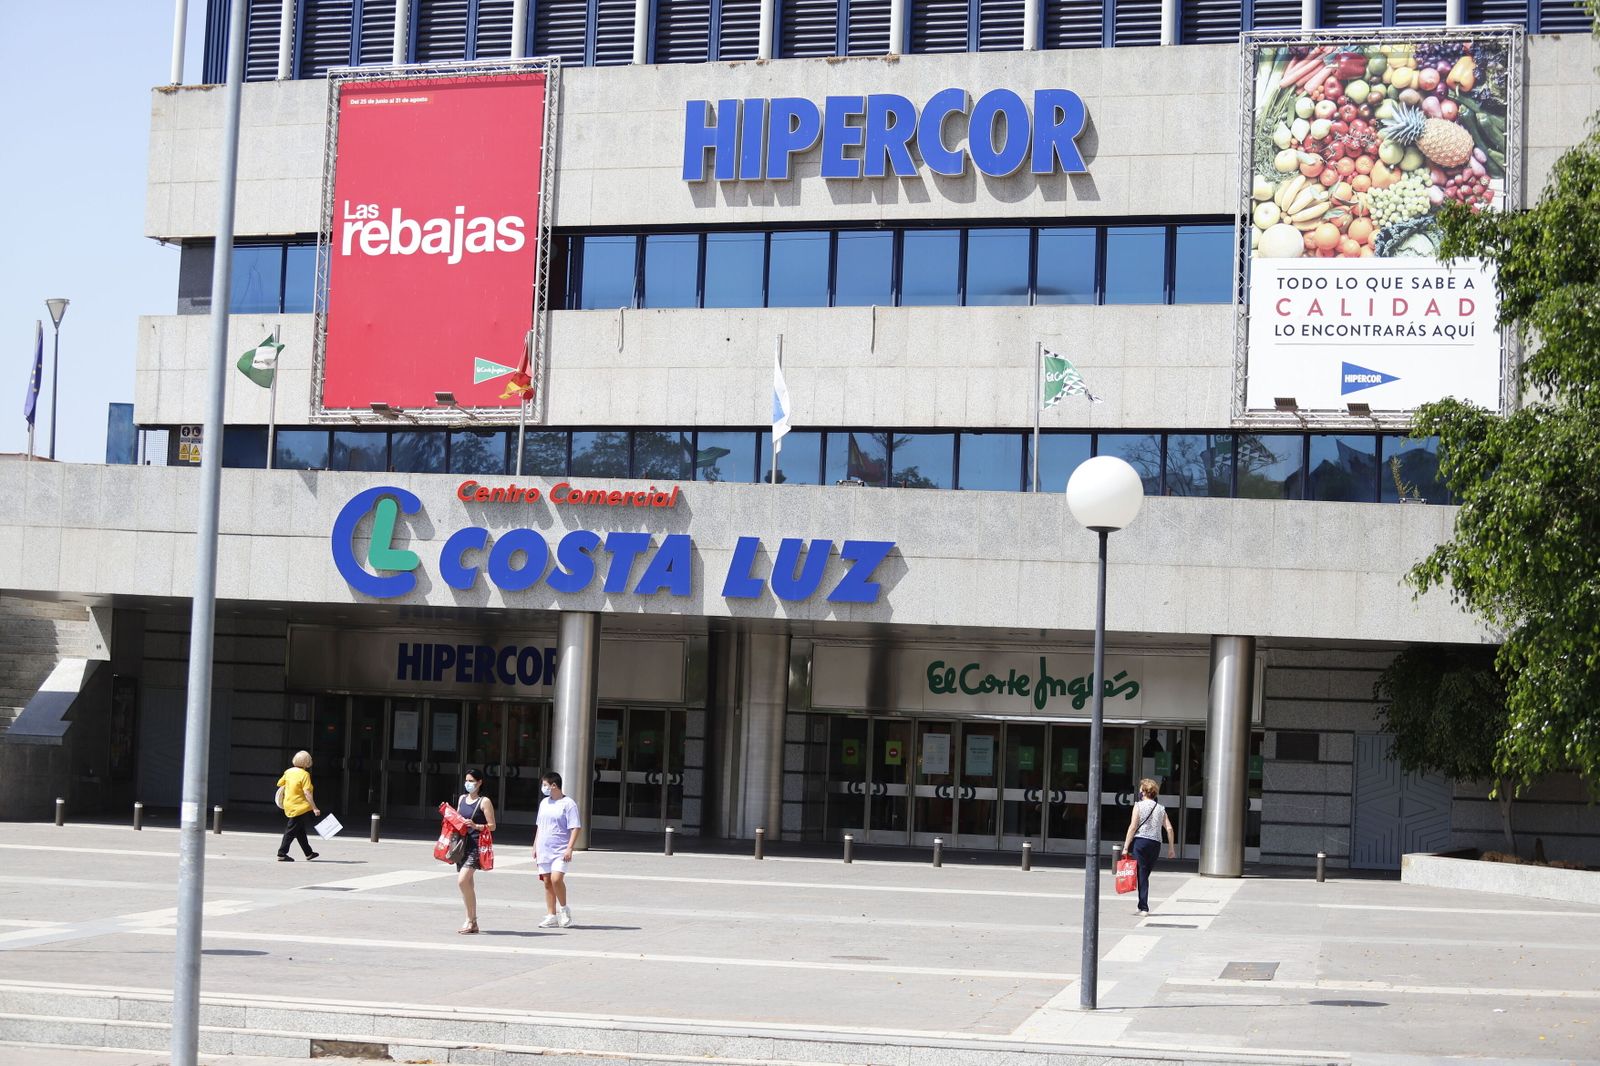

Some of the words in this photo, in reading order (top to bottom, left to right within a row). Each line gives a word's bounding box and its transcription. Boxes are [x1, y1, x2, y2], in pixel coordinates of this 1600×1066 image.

[682, 87, 1089, 182] HIPERCOR
[343, 200, 380, 220] Las
[341, 205, 526, 265] rebajas
[1277, 277, 1328, 290] TODO
[1336, 277, 1358, 290] LO
[1366, 277, 1404, 292] QUE
[1411, 277, 1456, 290] SABE
[1463, 277, 1475, 290] A
[1275, 297, 1476, 317] CALIDAD
[1274, 324, 1295, 337] LO
[1301, 321, 1427, 337] ENCONTRARÁS
[1432, 321, 1475, 340] AQUÍ
[1344, 373, 1382, 384] HIPERCOR
[456, 480, 541, 504] Centro
[549, 482, 680, 508] Comercial
[439, 526, 693, 598] COSTA
[721, 536, 897, 604] LUZ
[927, 660, 957, 694] El
[959, 662, 1031, 697] Corte
